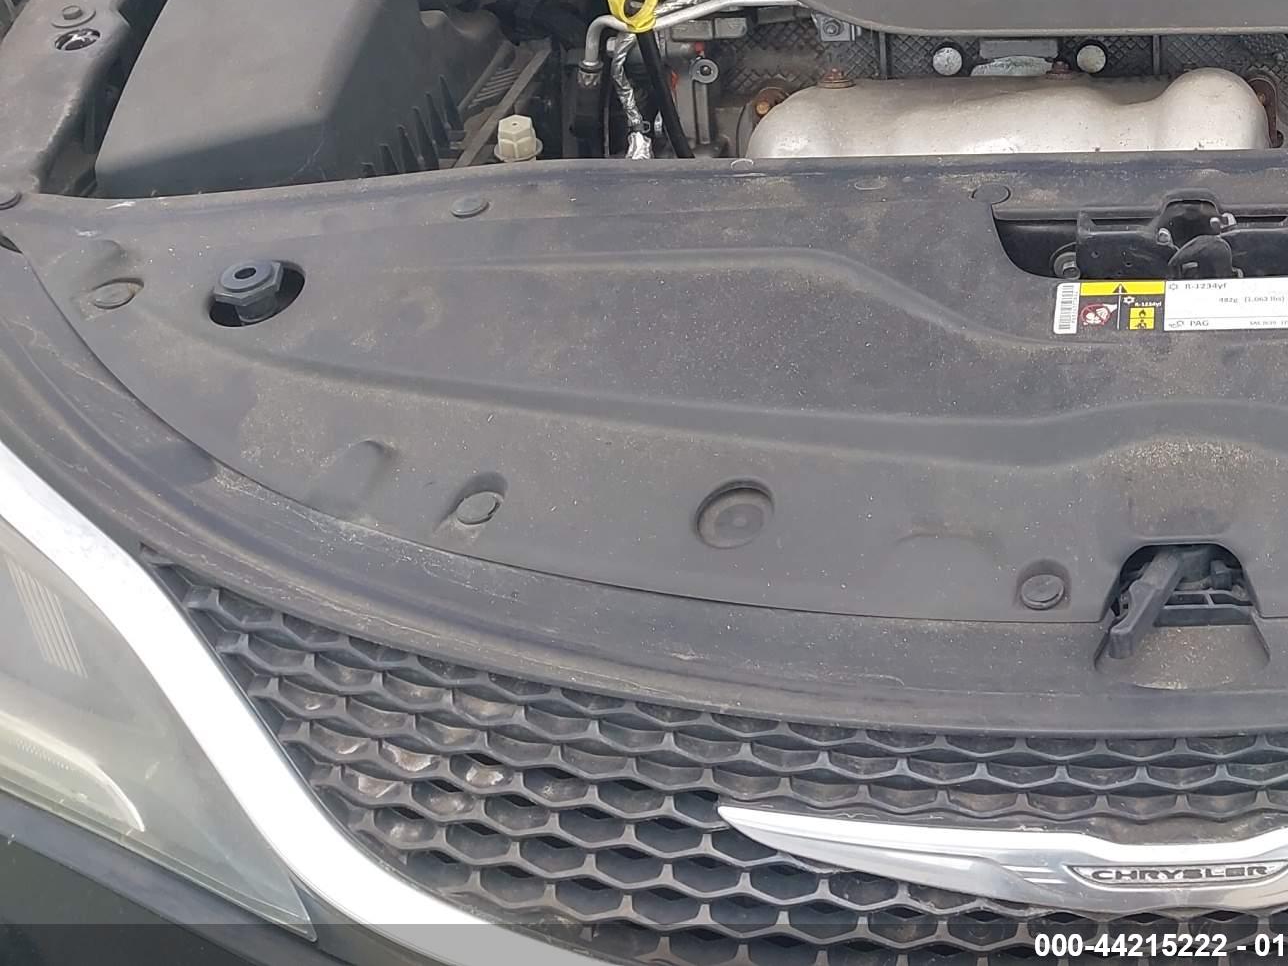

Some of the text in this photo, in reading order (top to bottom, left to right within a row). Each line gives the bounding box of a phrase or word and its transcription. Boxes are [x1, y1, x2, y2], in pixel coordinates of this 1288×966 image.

[1184, 282, 1228, 291] R-1234yf
[1189, 319, 1210, 328] PAG
[1090, 865, 1270, 881] CHRYSLER
